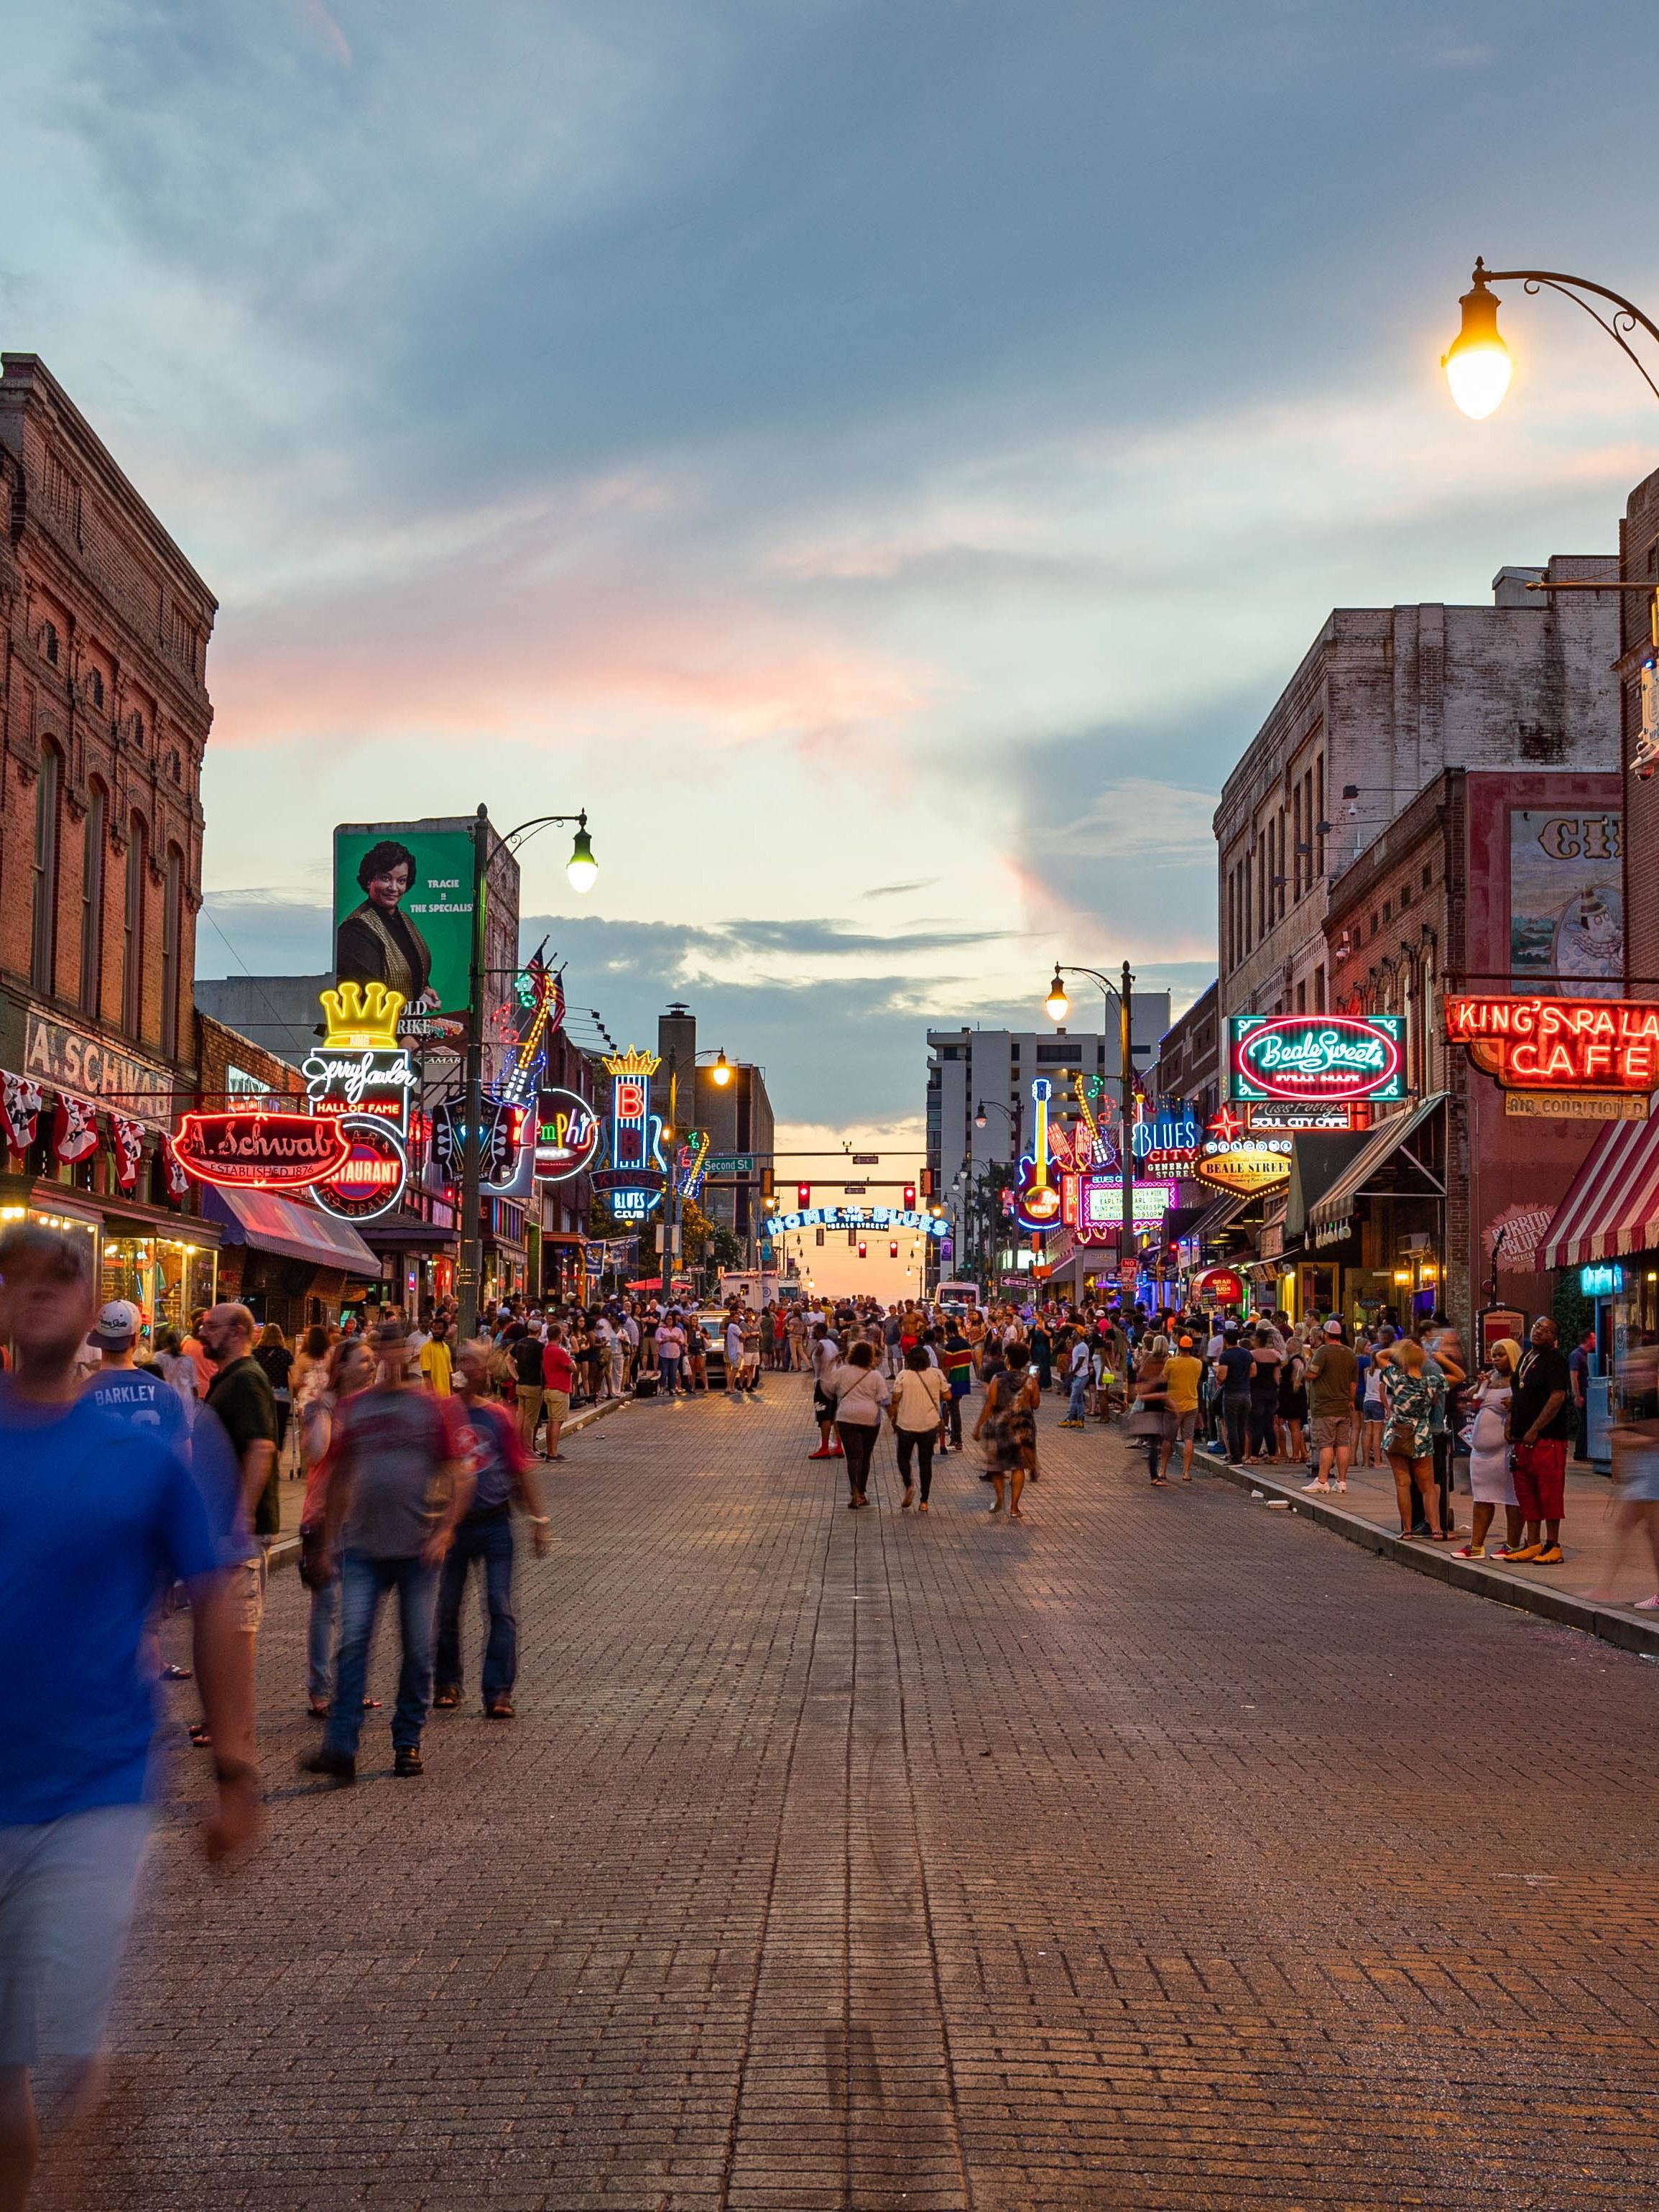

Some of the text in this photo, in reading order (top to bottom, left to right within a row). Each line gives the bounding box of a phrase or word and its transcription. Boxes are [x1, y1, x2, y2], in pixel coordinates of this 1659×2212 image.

[428, 880, 459, 888] TRACIE
[410, 903, 473, 913] THE SPECIALIS
[1459, 1001, 1561, 1033] KING'S
[1249, 1031, 1384, 1073] Beale Sweets
[1512, 1044, 1651, 1076] CAFE
[63, 1036, 169, 1120] SCHWAB
[316, 1103, 400, 1114] HALL OF FAME
[1510, 1099, 1644, 1114] AIR CONDITIONED
[1251, 1117, 1349, 1128] SOUL CITY CAFE
[182, 1120, 339, 1157] A. Schwab
[1140, 1121, 1194, 1156] BLUES
[1150, 1149, 1196, 1161] CITY
[211, 1163, 314, 1177] ESTABLISHED 1876
[705, 1159, 750, 1171] Second St
[1207, 1163, 1244, 1174] BEALE
[614, 1192, 645, 1209] BLUES
[614, 1209, 644, 1219] CLUB
[767, 1207, 837, 1235] HOME
[872, 1207, 948, 1236] BLUES
[95, 1386, 155, 1406] BARKLEY
